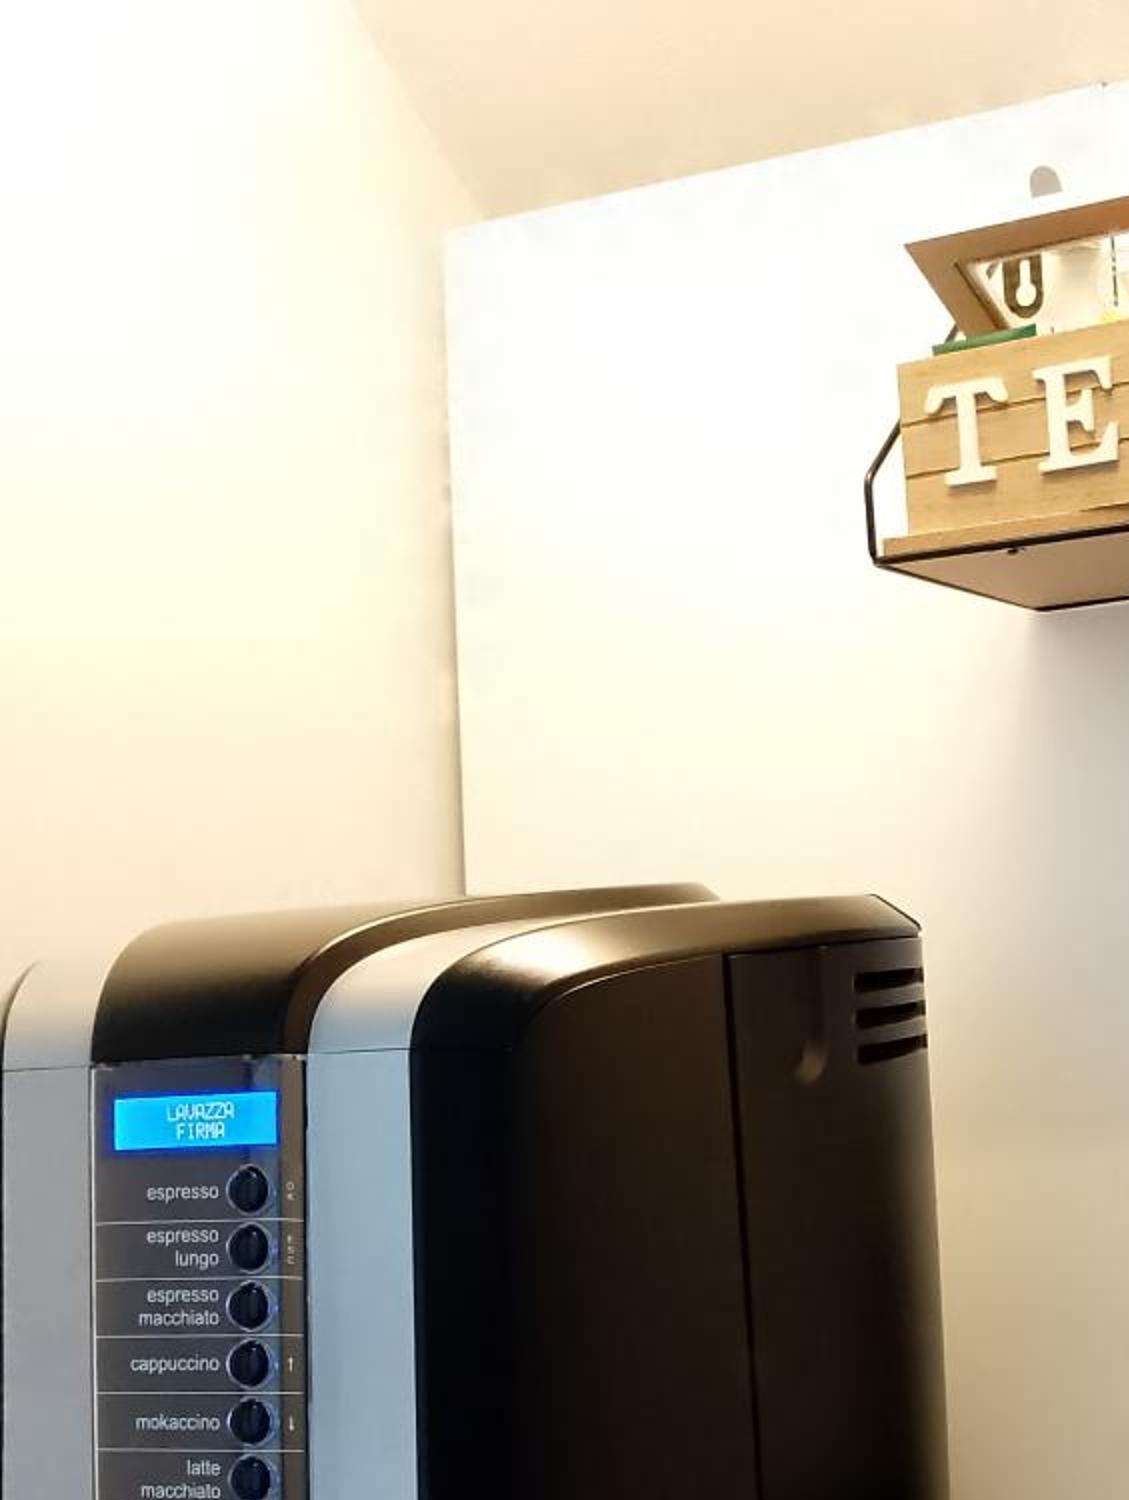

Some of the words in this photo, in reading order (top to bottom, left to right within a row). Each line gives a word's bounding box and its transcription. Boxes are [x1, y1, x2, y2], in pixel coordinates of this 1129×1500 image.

[167, 1101, 235, 1122] LAVAZZA
[176, 1122, 225, 1139] FIRMA
[147, 1186, 219, 1203] espresso
[147, 1230, 219, 1247] espresso
[175, 1251, 219, 1270] lungo
[147, 1289, 219, 1306] espresso
[138, 1310, 220, 1326] macchiato
[130, 1355, 220, 1375] cappuccino
[135, 1413, 220, 1430] mokaccino
[187, 1459, 221, 1476] latte
[141, 1483, 221, 1499] macchiato
